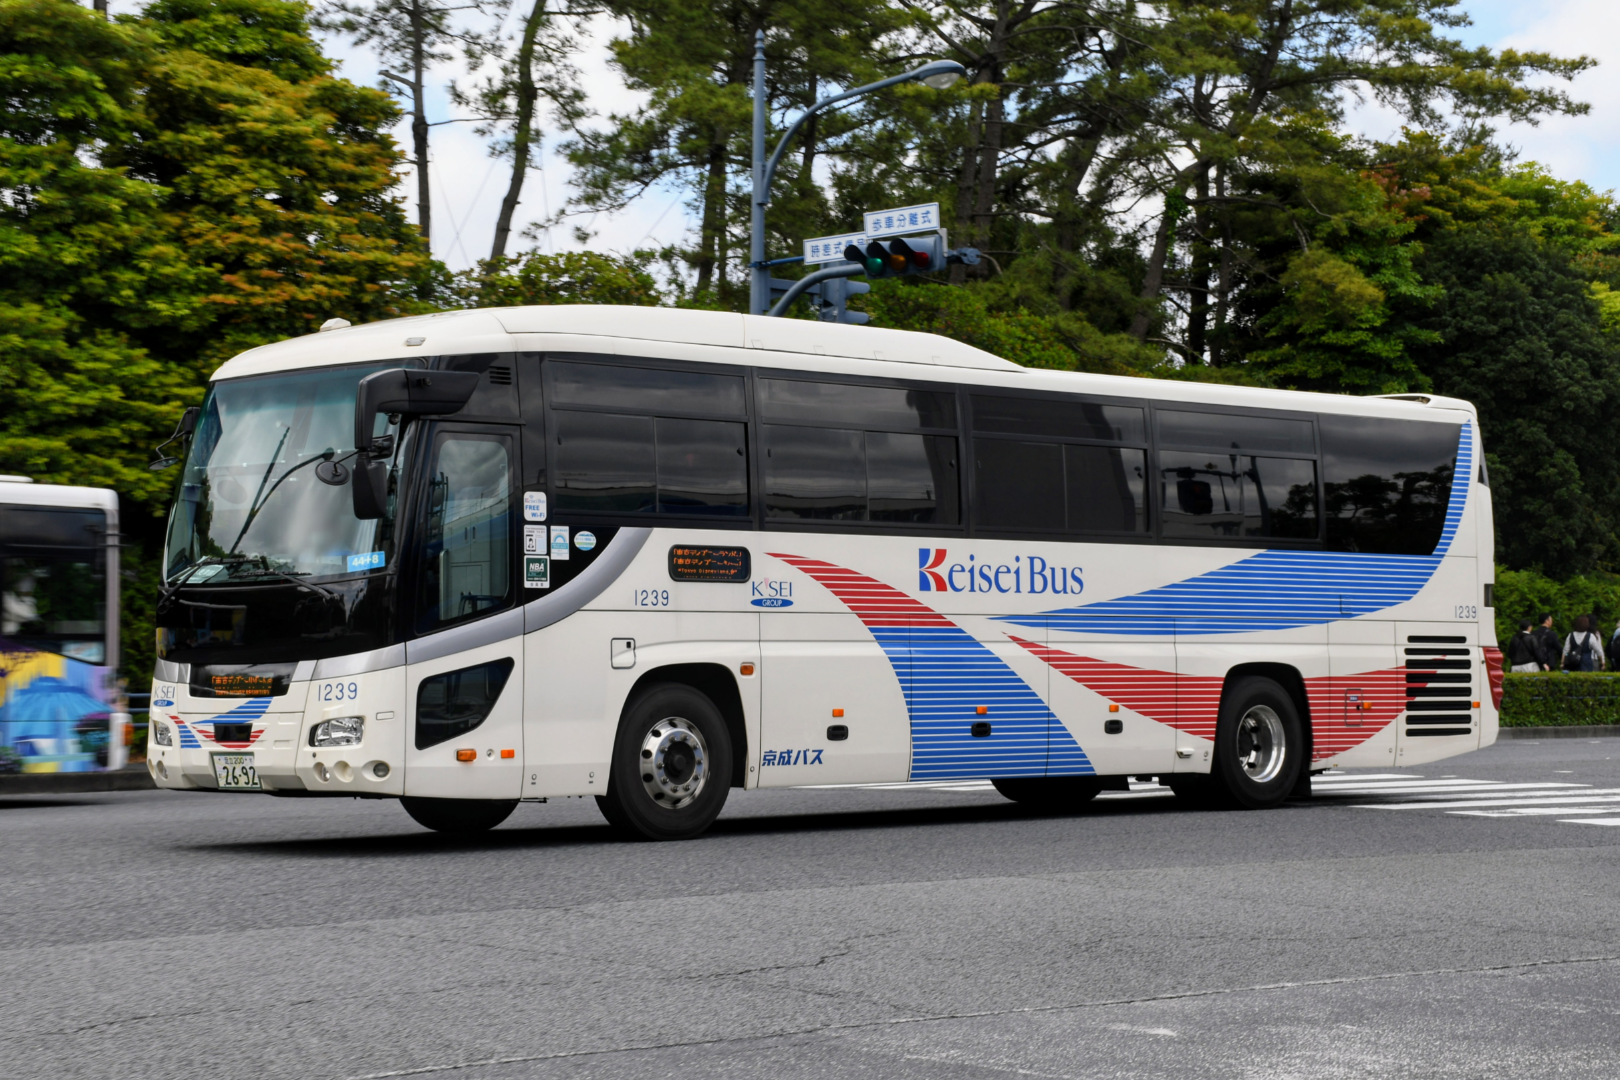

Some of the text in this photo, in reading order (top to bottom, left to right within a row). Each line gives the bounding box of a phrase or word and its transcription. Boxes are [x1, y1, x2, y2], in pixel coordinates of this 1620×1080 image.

[872, 210, 931, 232] 歩車分離式
[352, 554, 379, 566] 44+8
[529, 562, 545, 572] NBA
[634, 589, 669, 607] 1239
[762, 599, 783, 607] GROUP
[1455, 605, 1477, 619] 1239
[318, 682, 358, 702] 1239
[761, 748, 824, 766] 京成バス
